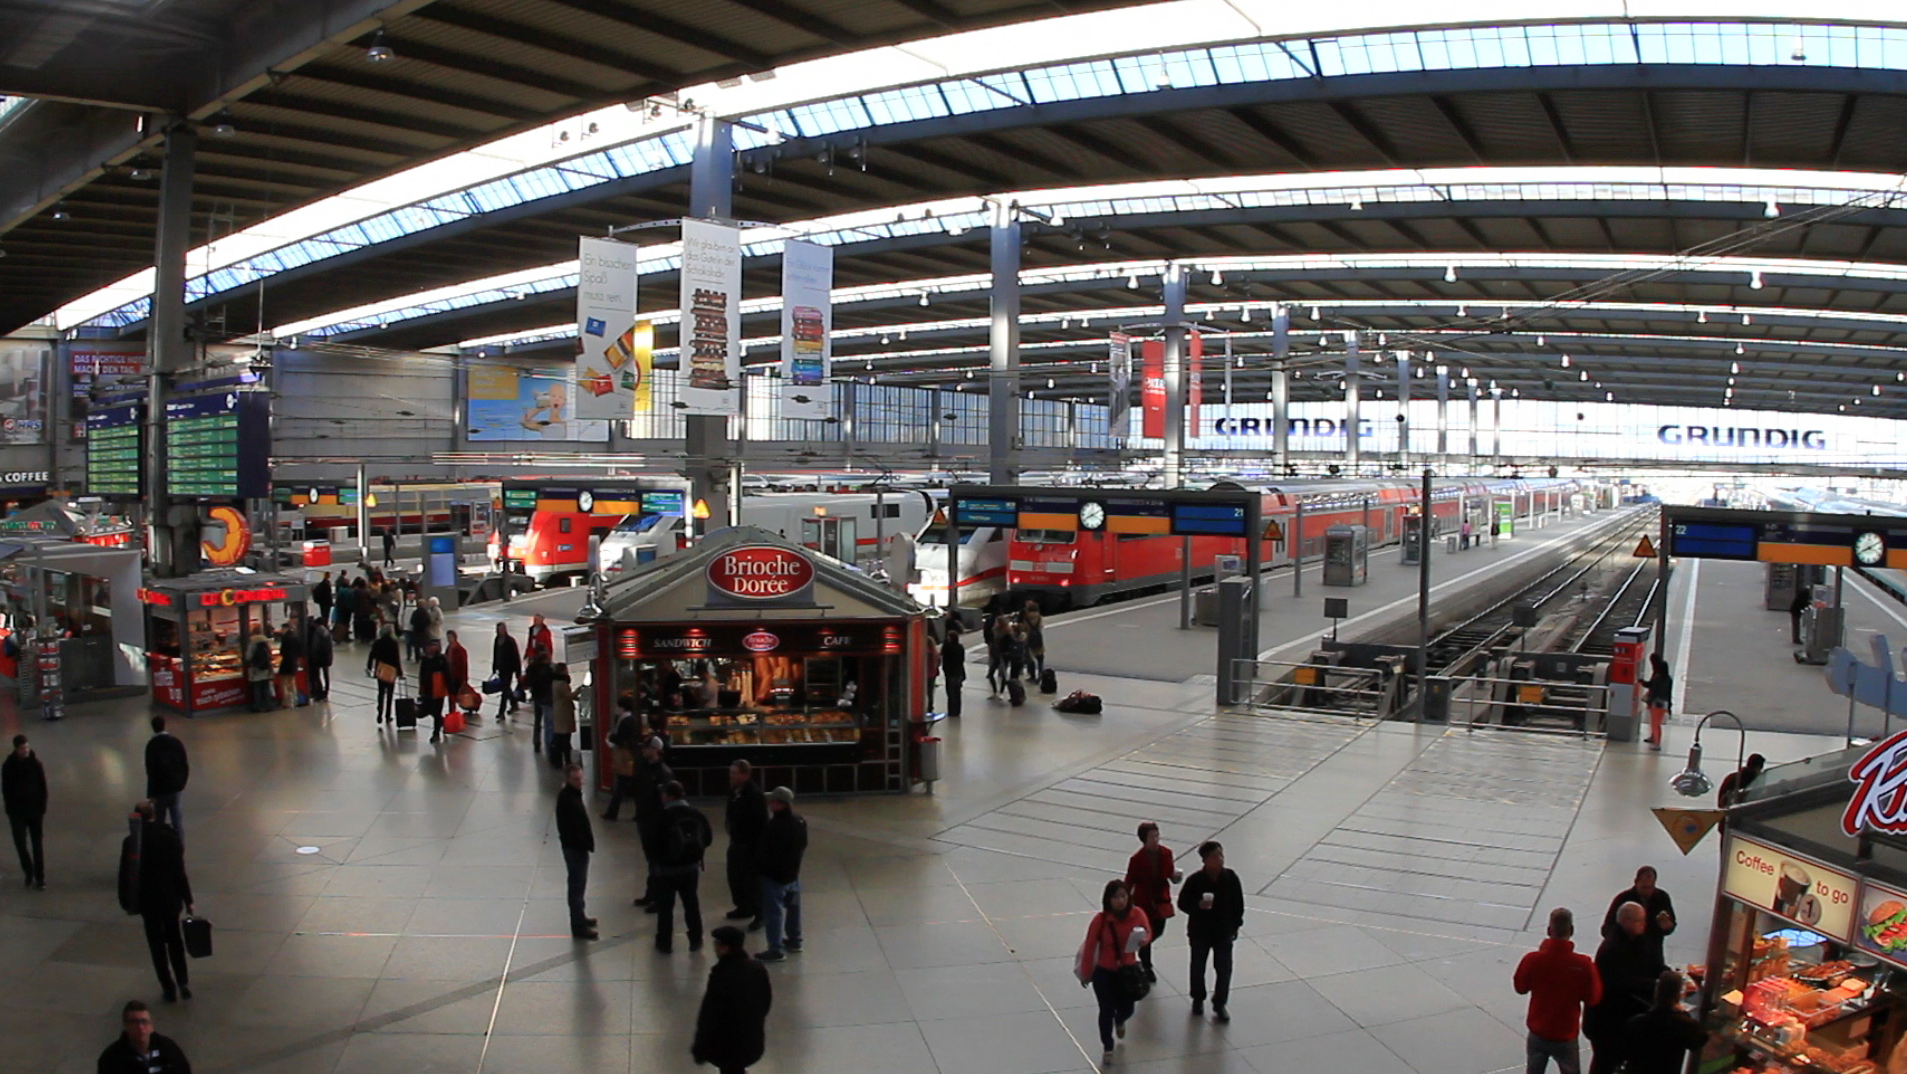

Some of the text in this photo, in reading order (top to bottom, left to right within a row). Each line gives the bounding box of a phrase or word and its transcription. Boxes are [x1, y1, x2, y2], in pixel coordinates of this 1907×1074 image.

[74, 354, 91, 363] DAS
[74, 365, 101, 373] MACT
[1657, 424, 1826, 450] GRUNDIG
[4, 471, 49, 483] COFFEE
[1234, 507, 1244, 518] 21
[1675, 525, 1687, 535] 22
[724, 554, 801, 576] Brioche
[734, 575, 788, 593] Dorée
[654, 638, 712, 648] SANDWICH
[1736, 850, 1850, 905] Coffee to go
